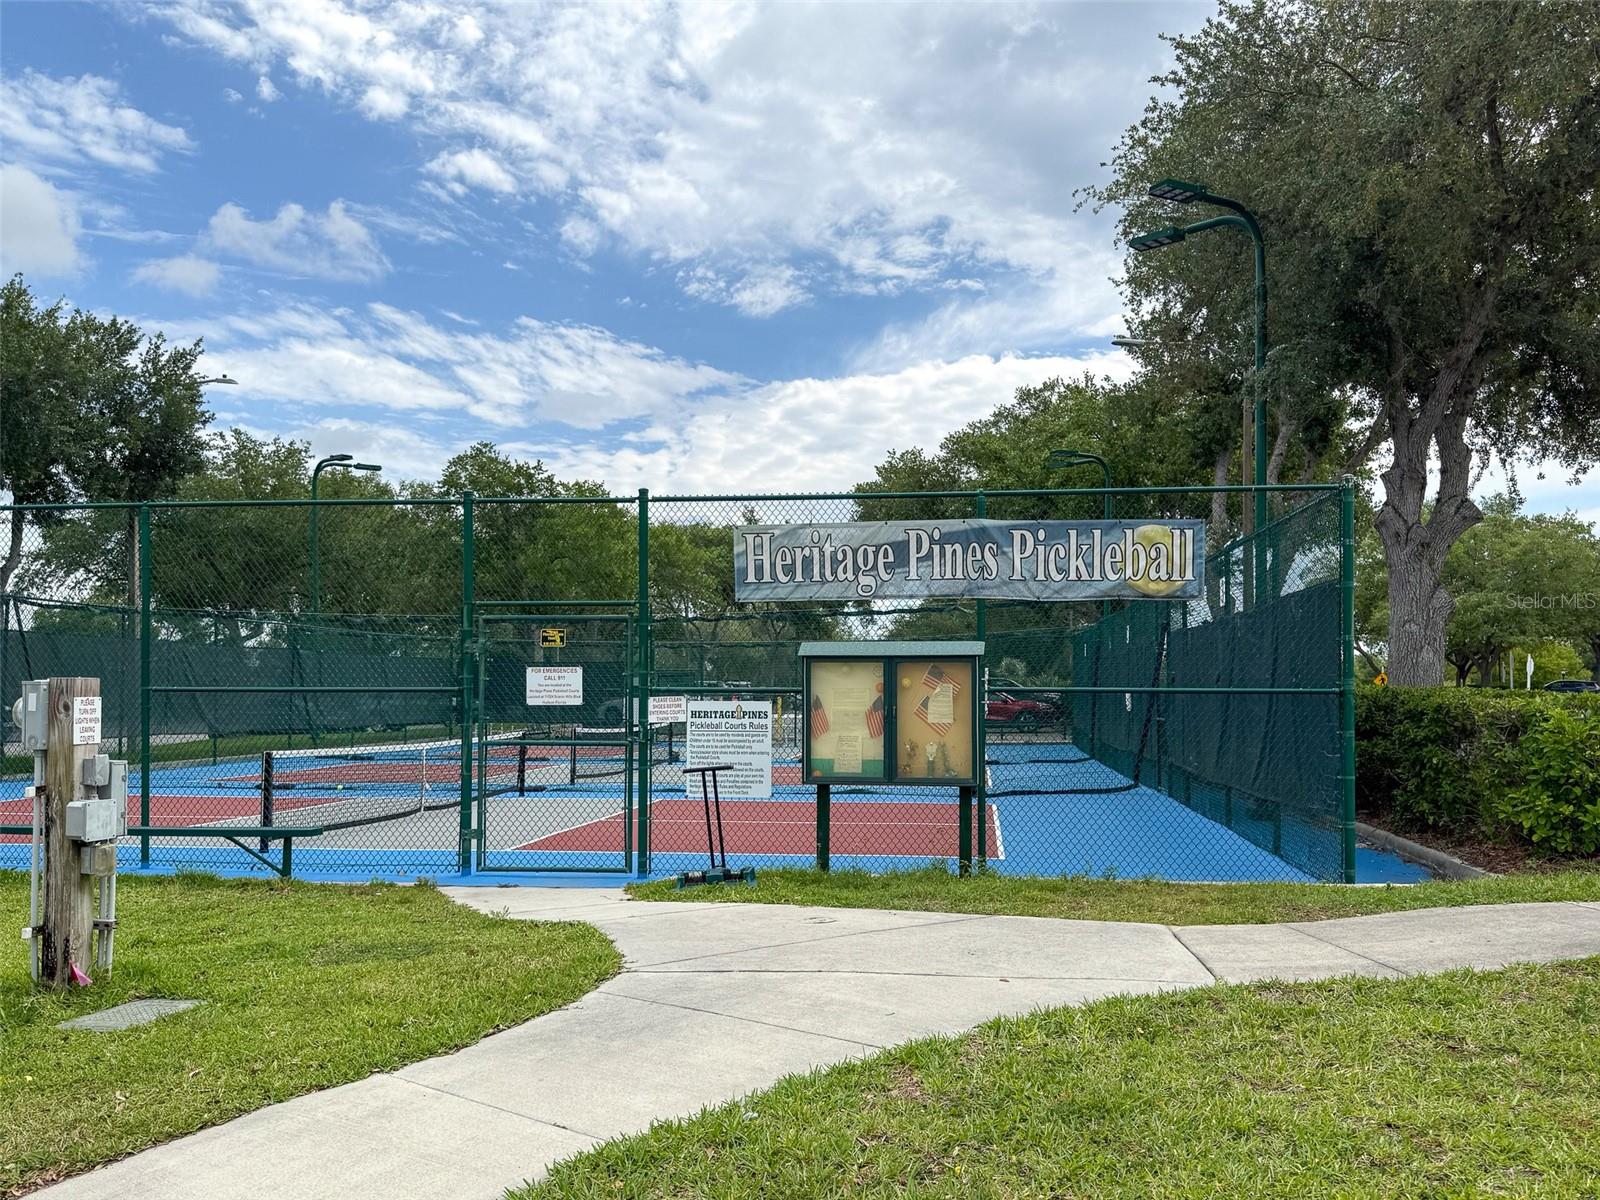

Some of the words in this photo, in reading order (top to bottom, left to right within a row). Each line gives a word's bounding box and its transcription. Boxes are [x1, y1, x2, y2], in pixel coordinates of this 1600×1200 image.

[741, 530, 895, 596] Heritage
[904, 527, 998, 583] Pines
[1009, 524, 1196, 583] Pickleball
[690, 710, 736, 719] HERITAGE
[742, 710, 768, 719] PINES
[690, 722, 722, 730] Pickleball
[724, 722, 746, 730] Courts
[749, 722, 768, 730] Rules
